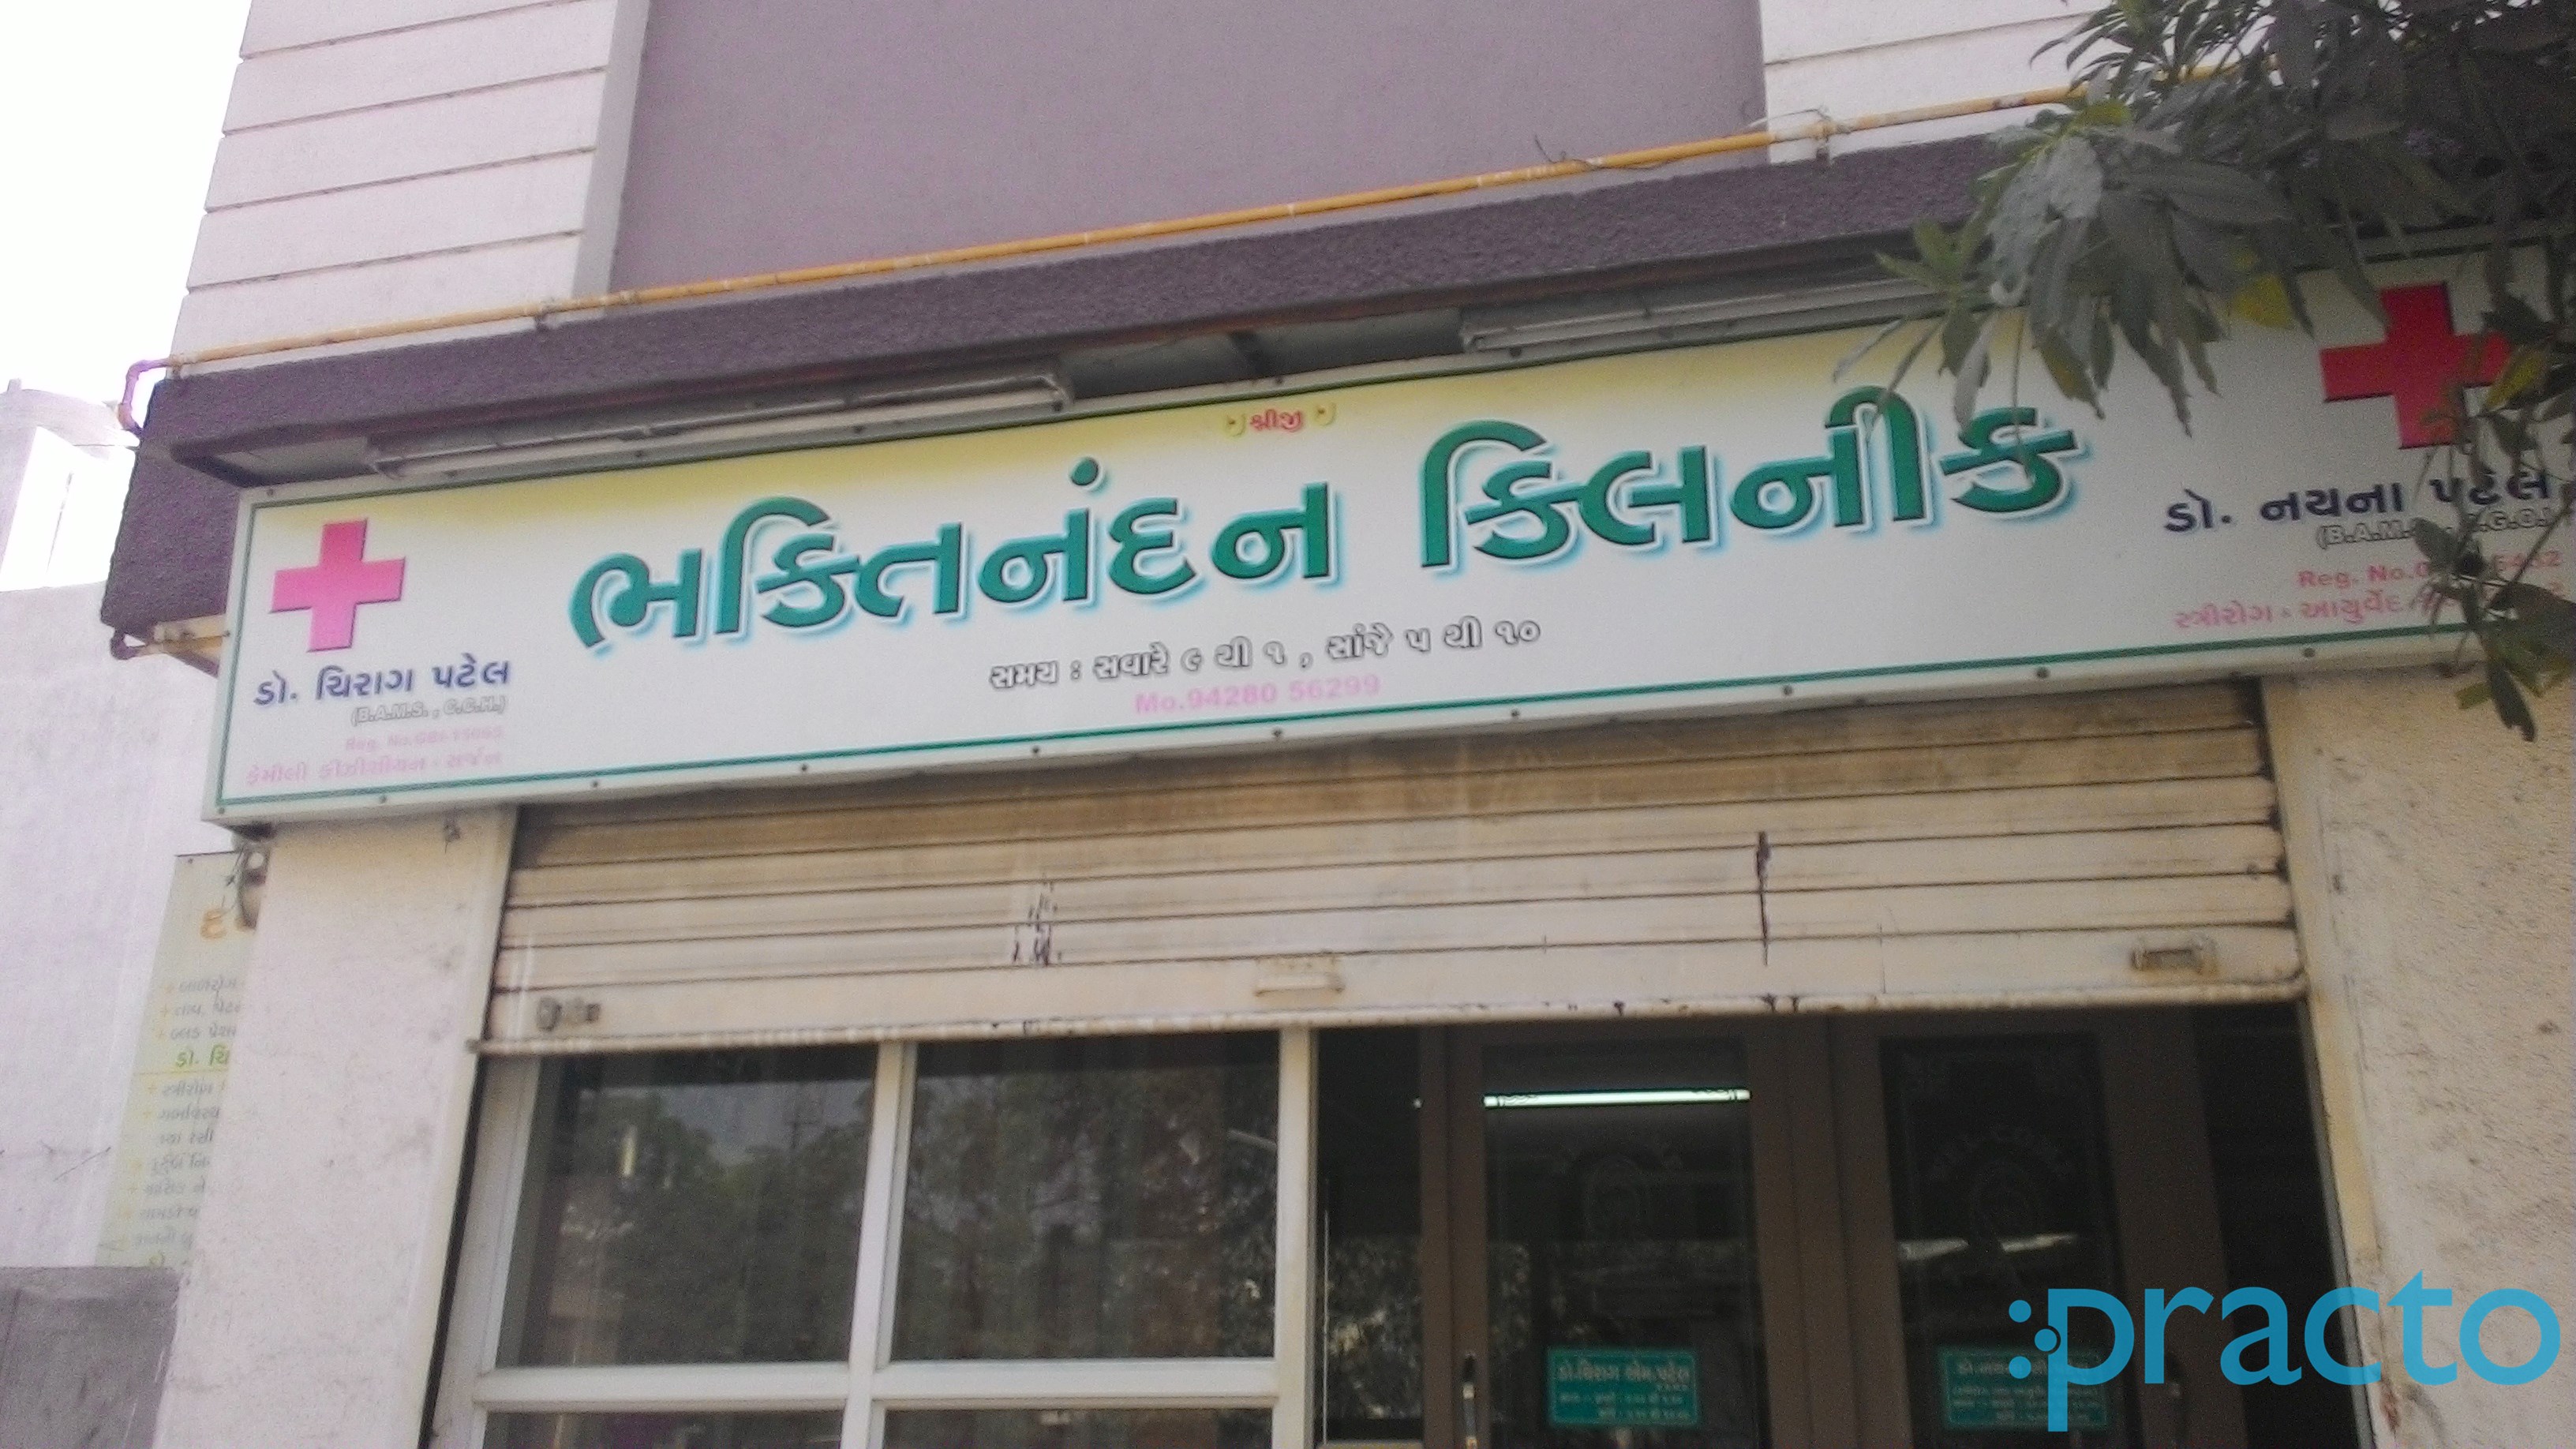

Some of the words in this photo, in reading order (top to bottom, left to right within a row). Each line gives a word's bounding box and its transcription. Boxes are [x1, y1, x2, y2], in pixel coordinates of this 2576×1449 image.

[2164, 487, 2232, 532] ડો.
[2260, 483, 2404, 522] નયના
[2297, 570, 2358, 589] Reg.
[316, 665, 413, 701] ચિરાગ
[432, 652, 509, 688] પટેલ
[989, 660, 1059, 690] સમય
[1092, 642, 1170, 680] સવારે
